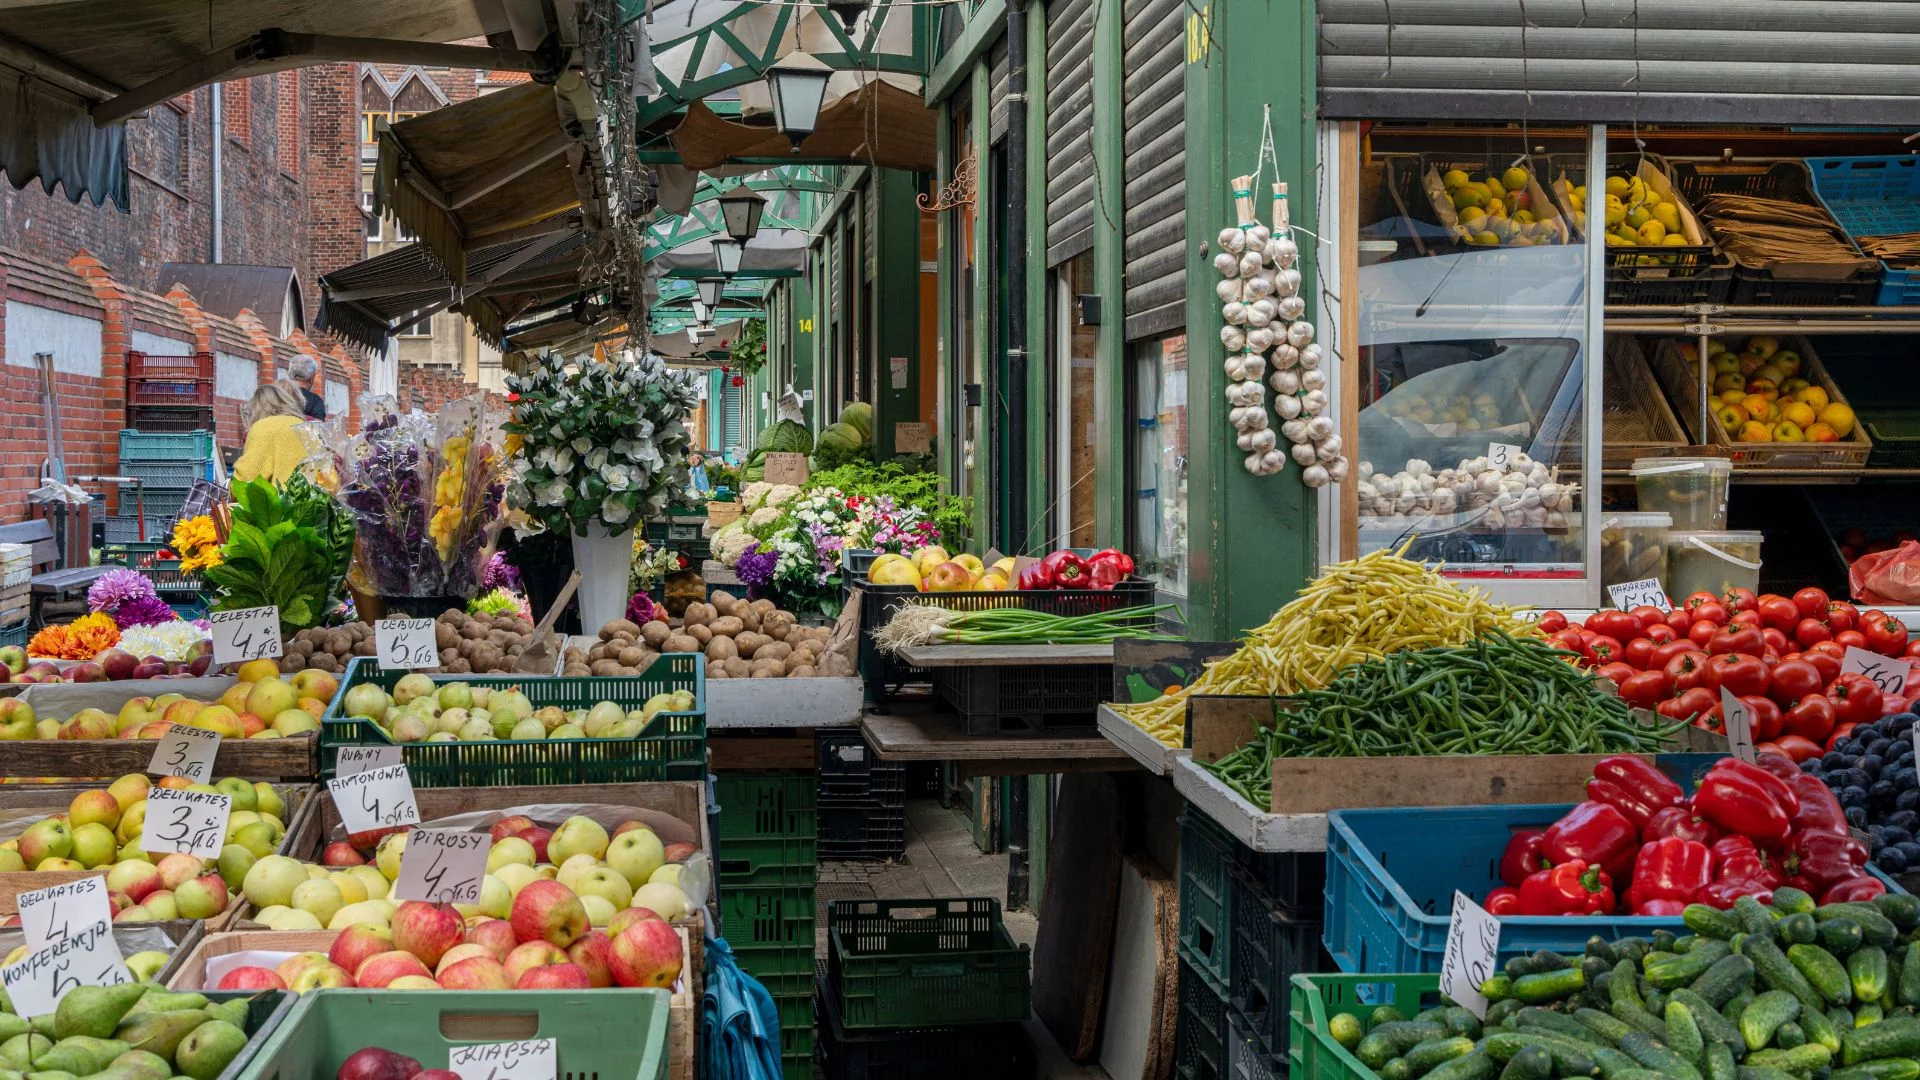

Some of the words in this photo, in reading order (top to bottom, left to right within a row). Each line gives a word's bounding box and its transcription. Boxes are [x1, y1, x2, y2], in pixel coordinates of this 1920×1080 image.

[799, 319, 812, 333] 14
[1494, 445, 1507, 465] 3
[211, 606, 274, 623] CELESTA
[381, 618, 432, 630] CEBULA
[390, 633, 410, 664] 5
[169, 723, 217, 740] CELESTA
[166, 741, 190, 766] 3
[155, 805, 193, 841] 3
[2, 920, 110, 987] KONFERENCJA
